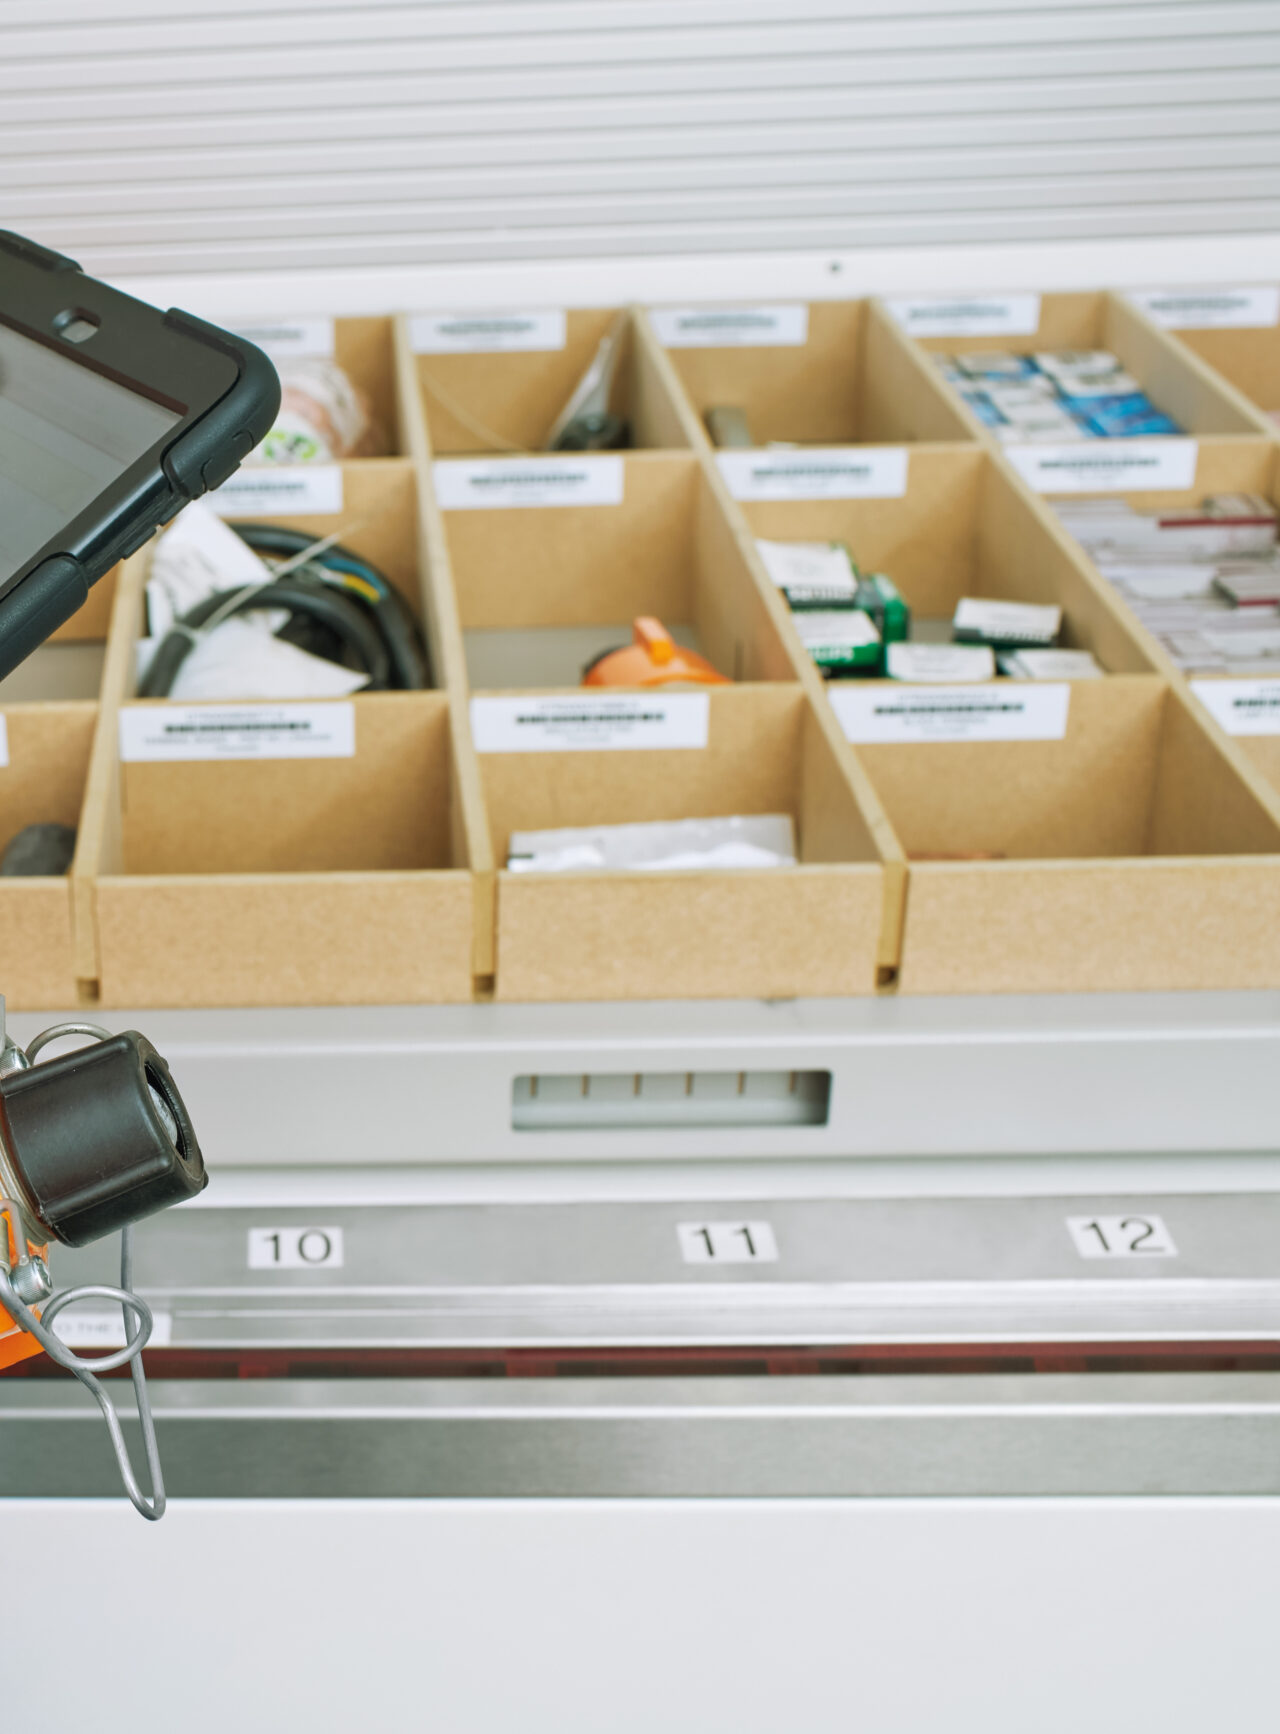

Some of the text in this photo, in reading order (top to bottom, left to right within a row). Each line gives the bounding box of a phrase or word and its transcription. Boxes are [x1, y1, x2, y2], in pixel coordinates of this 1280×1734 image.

[263, 1229, 331, 1264] 10
[691, 1227, 756, 1257] 11
[1083, 1217, 1166, 1253] 12
